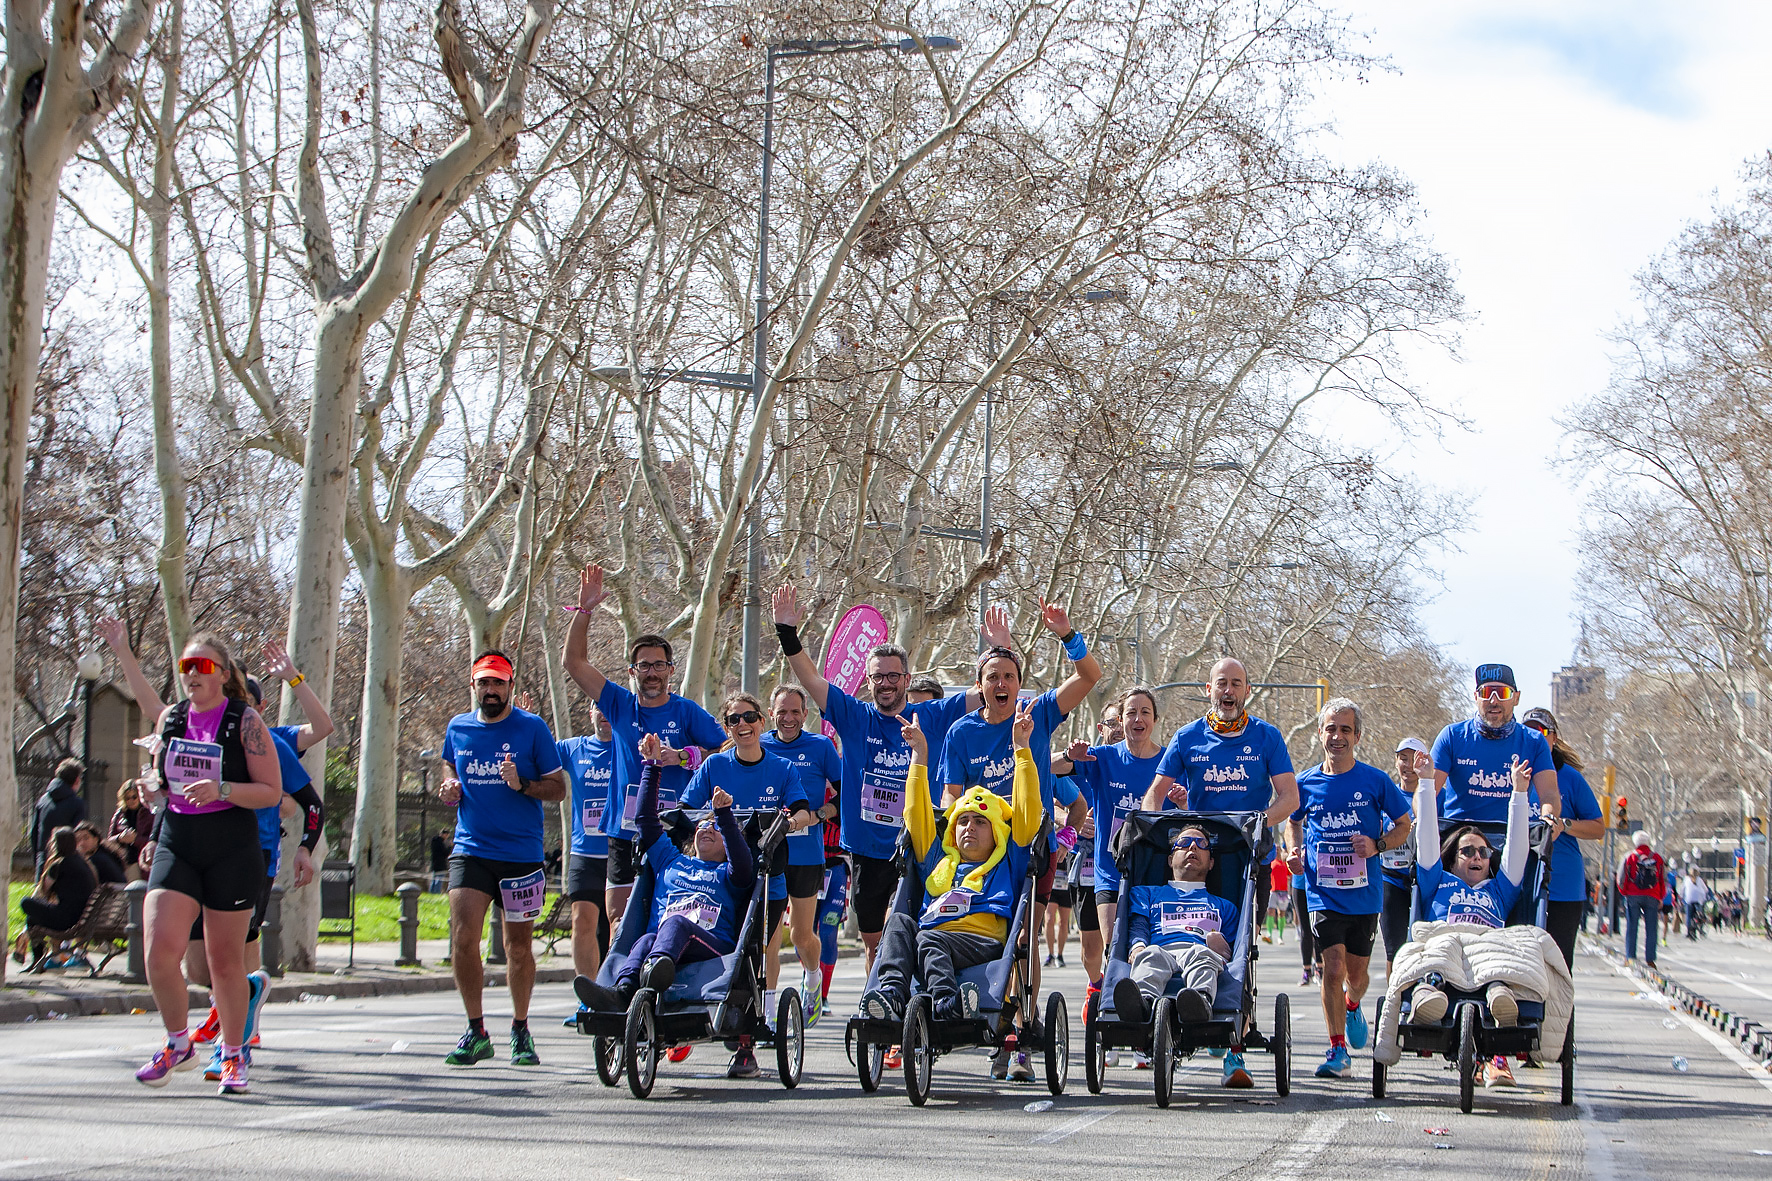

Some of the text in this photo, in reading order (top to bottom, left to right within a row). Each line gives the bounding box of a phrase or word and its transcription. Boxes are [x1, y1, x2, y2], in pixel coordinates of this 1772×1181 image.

[833, 621, 877, 689] aefat
[1457, 758, 1477, 766] aefat
[873, 768, 909, 776] #Imparable
[882, 781, 901, 789] ZURICH
[1205, 784, 1247, 793] #Imparables
[873, 788, 899, 803] MARC
[1468, 789, 1511, 798] #Imparables
[879, 802, 889, 810] 493
[1329, 855, 1354, 866] ORIOL
[674, 879, 716, 894] #Imparables
[512, 885, 539, 900] FRAN J
